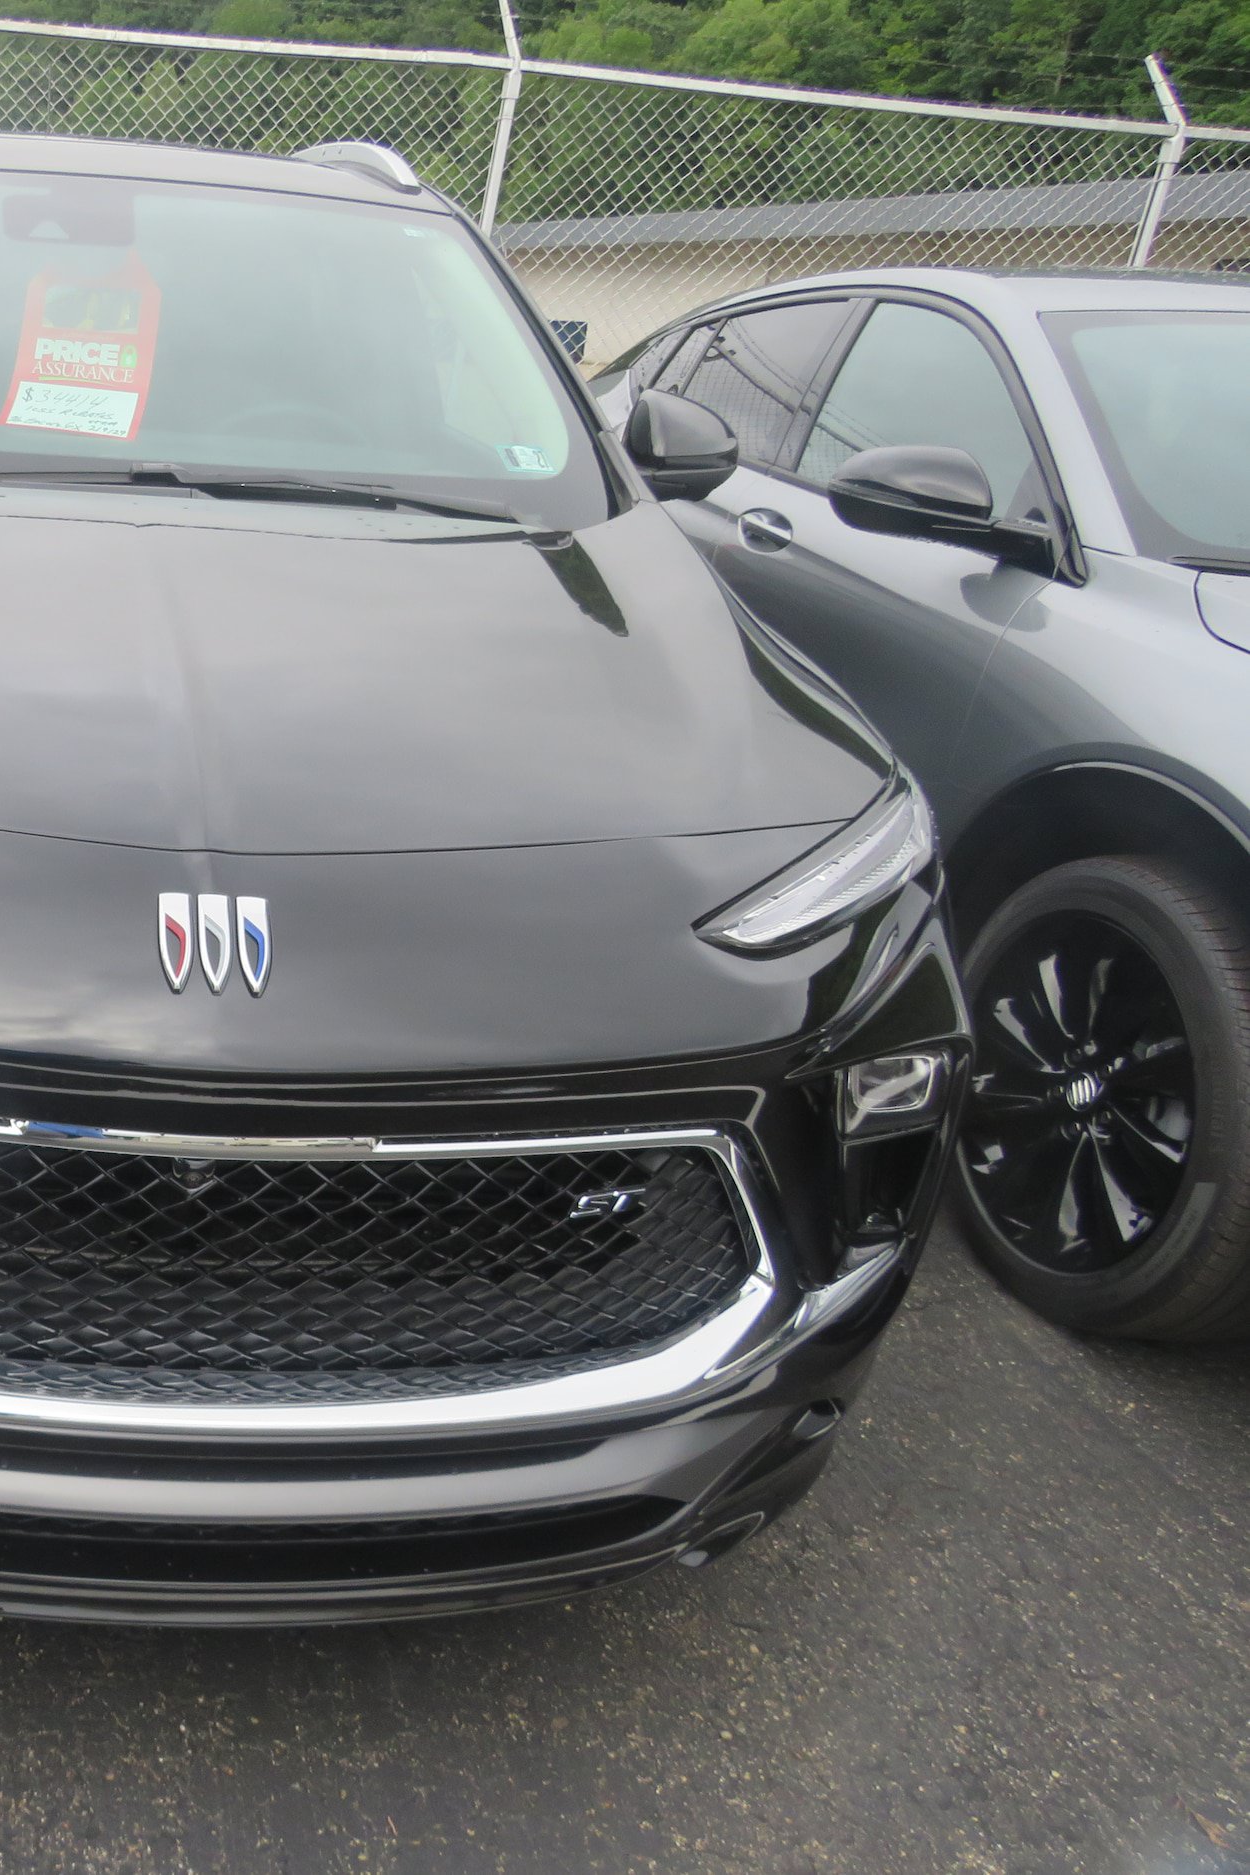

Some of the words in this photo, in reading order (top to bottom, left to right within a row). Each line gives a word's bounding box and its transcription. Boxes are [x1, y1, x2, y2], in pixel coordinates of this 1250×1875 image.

[34, 337, 120, 367] PRICE
[32, 360, 135, 384] ASSURANCE
[570, 1188, 646, 1218] ST
